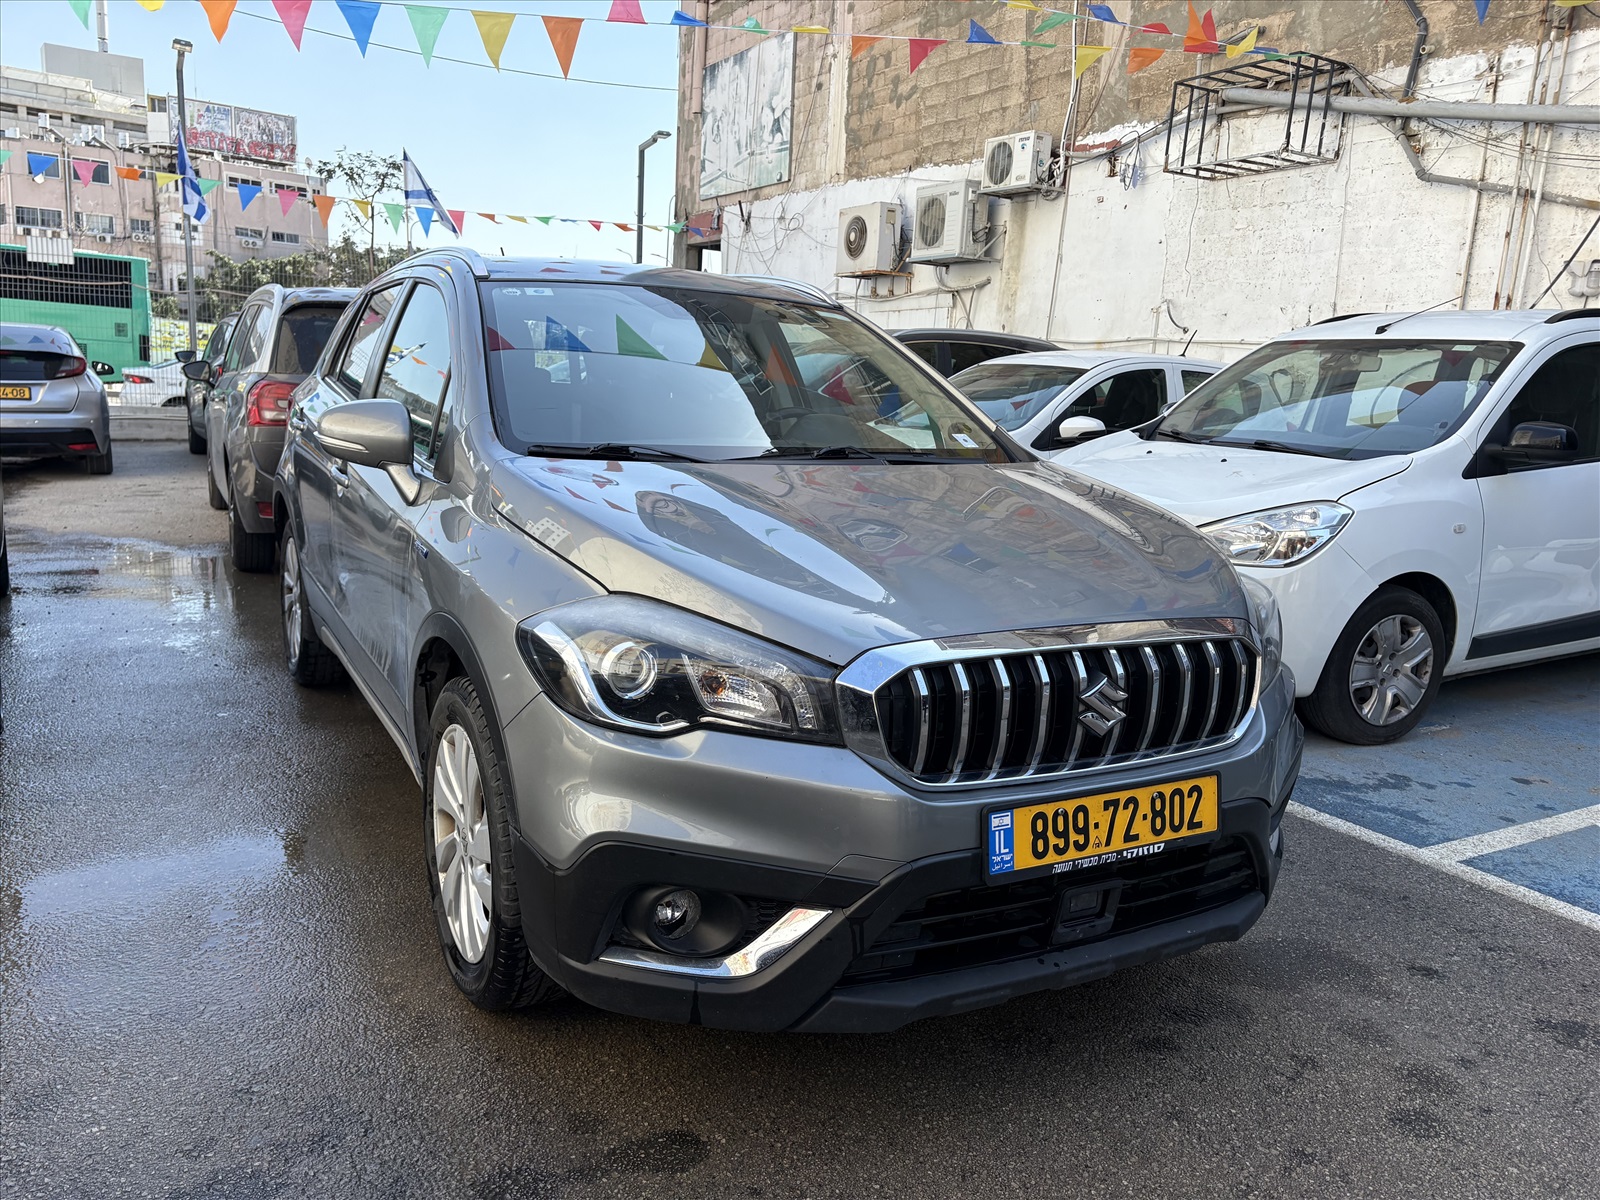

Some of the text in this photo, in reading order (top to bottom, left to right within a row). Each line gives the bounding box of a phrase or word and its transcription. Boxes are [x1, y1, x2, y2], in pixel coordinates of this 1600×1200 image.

[0, 388, 26, 398] 4-08
[995, 831, 1009, 854] IL
[1123, 843, 1165, 859] סוזוקי
[991, 853, 1013, 863] ישראל
[1075, 856, 1099, 869] מכשירי
[1100, 853, 1117, 864] מבית
[1052, 861, 1073, 874] תנועה
